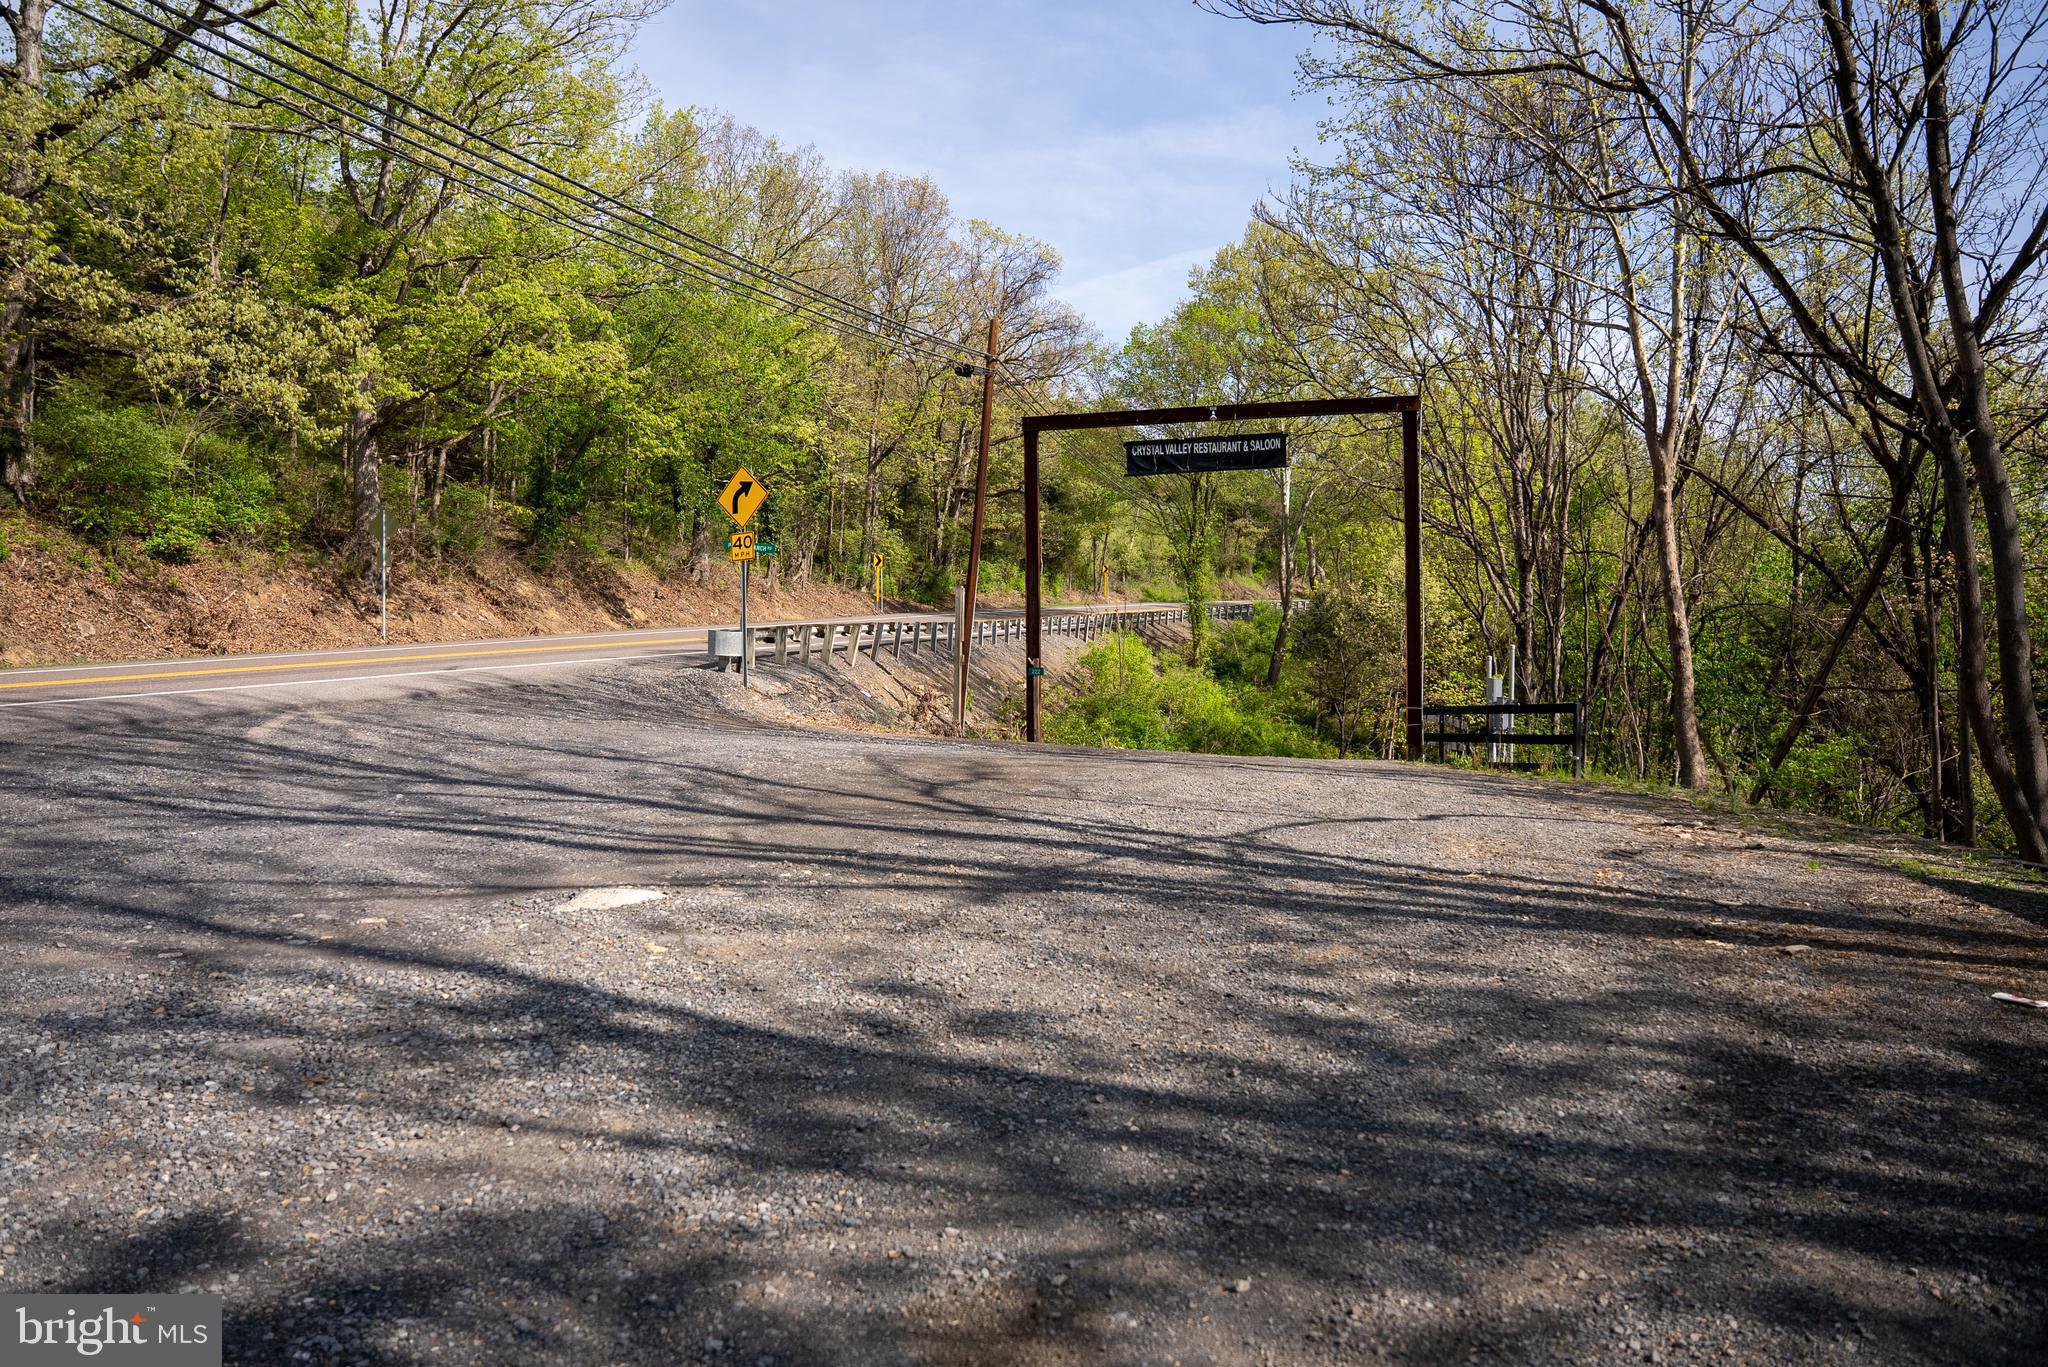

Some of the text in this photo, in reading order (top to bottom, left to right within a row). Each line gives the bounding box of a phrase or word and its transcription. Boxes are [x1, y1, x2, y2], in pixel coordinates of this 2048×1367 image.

[1132, 437, 1281, 456] CRYSTAL VALLEY RESTAURANT & SALOON
[733, 535, 752, 549] 40
